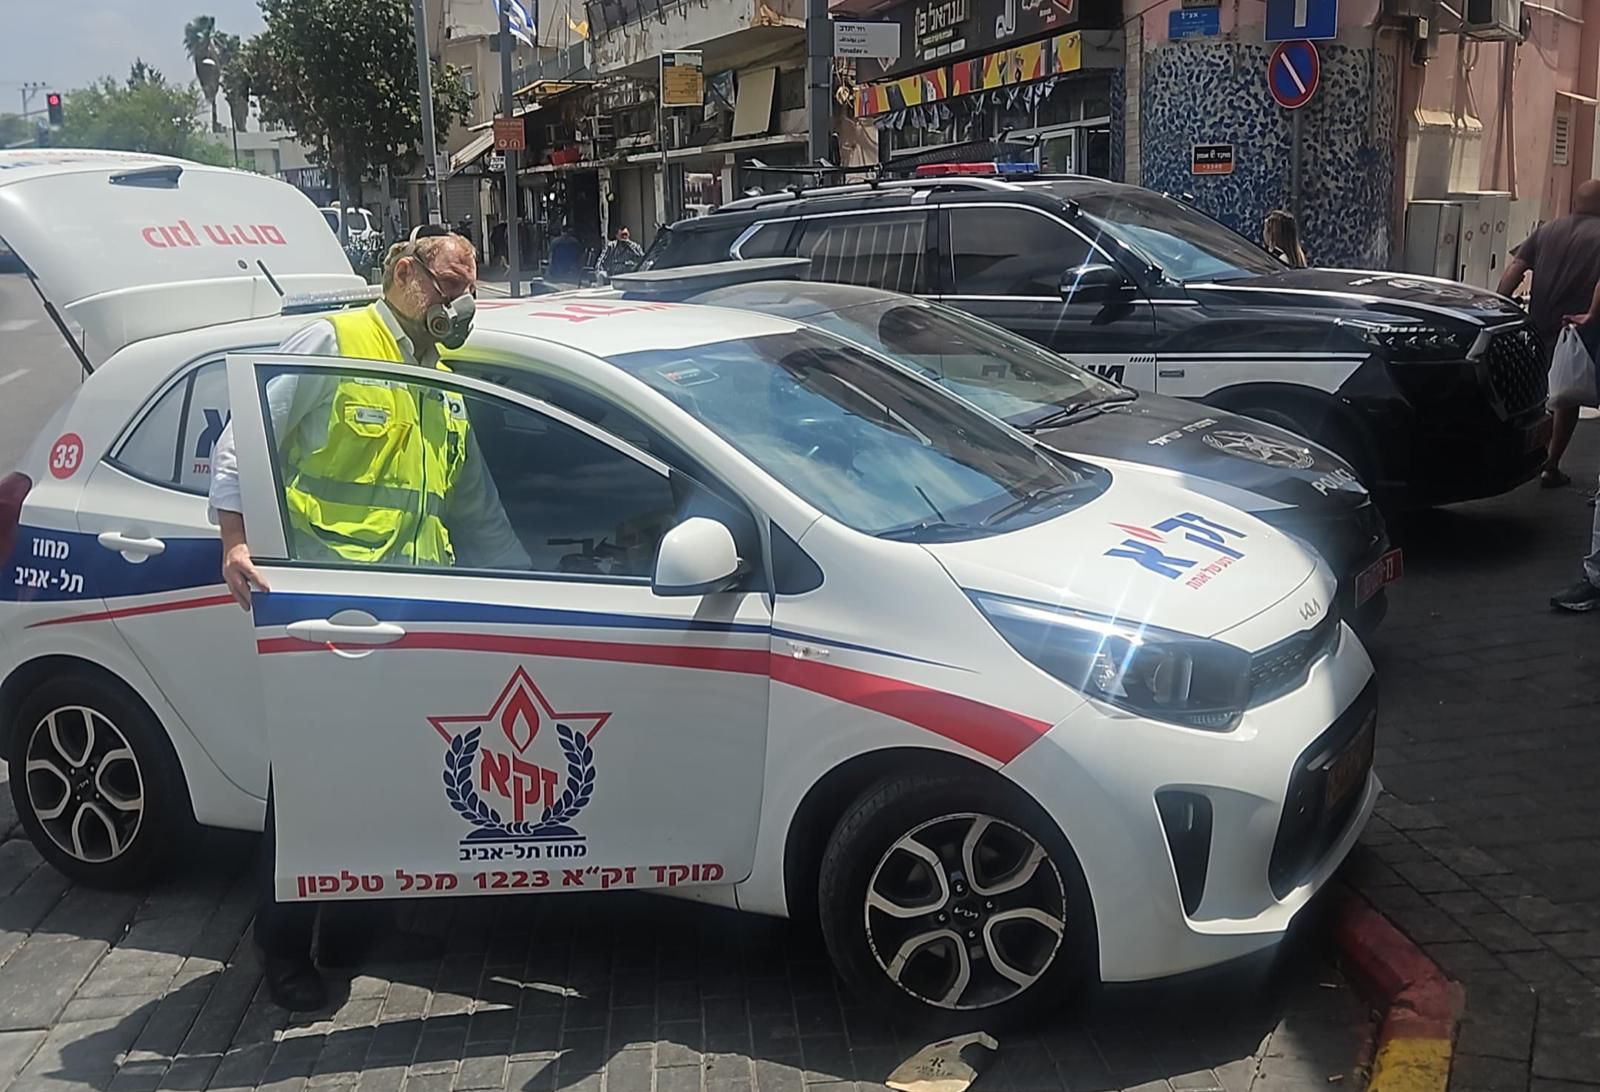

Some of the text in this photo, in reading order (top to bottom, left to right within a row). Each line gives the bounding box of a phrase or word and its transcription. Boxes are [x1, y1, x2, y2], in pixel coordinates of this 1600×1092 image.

[142, 220, 287, 248] כונן חירום
[53, 444, 79, 469] 33
[32, 537, 70, 560] מחוז
[14, 566, 84, 593] תל-אביב
[480, 747, 558, 822] זקא
[459, 843, 587, 861] מחוז תל-אביב
[297, 871, 384, 899] טלפון
[395, 869, 458, 892] מכל
[473, 869, 550, 891] 1223
[649, 863, 723, 886] מוקד
